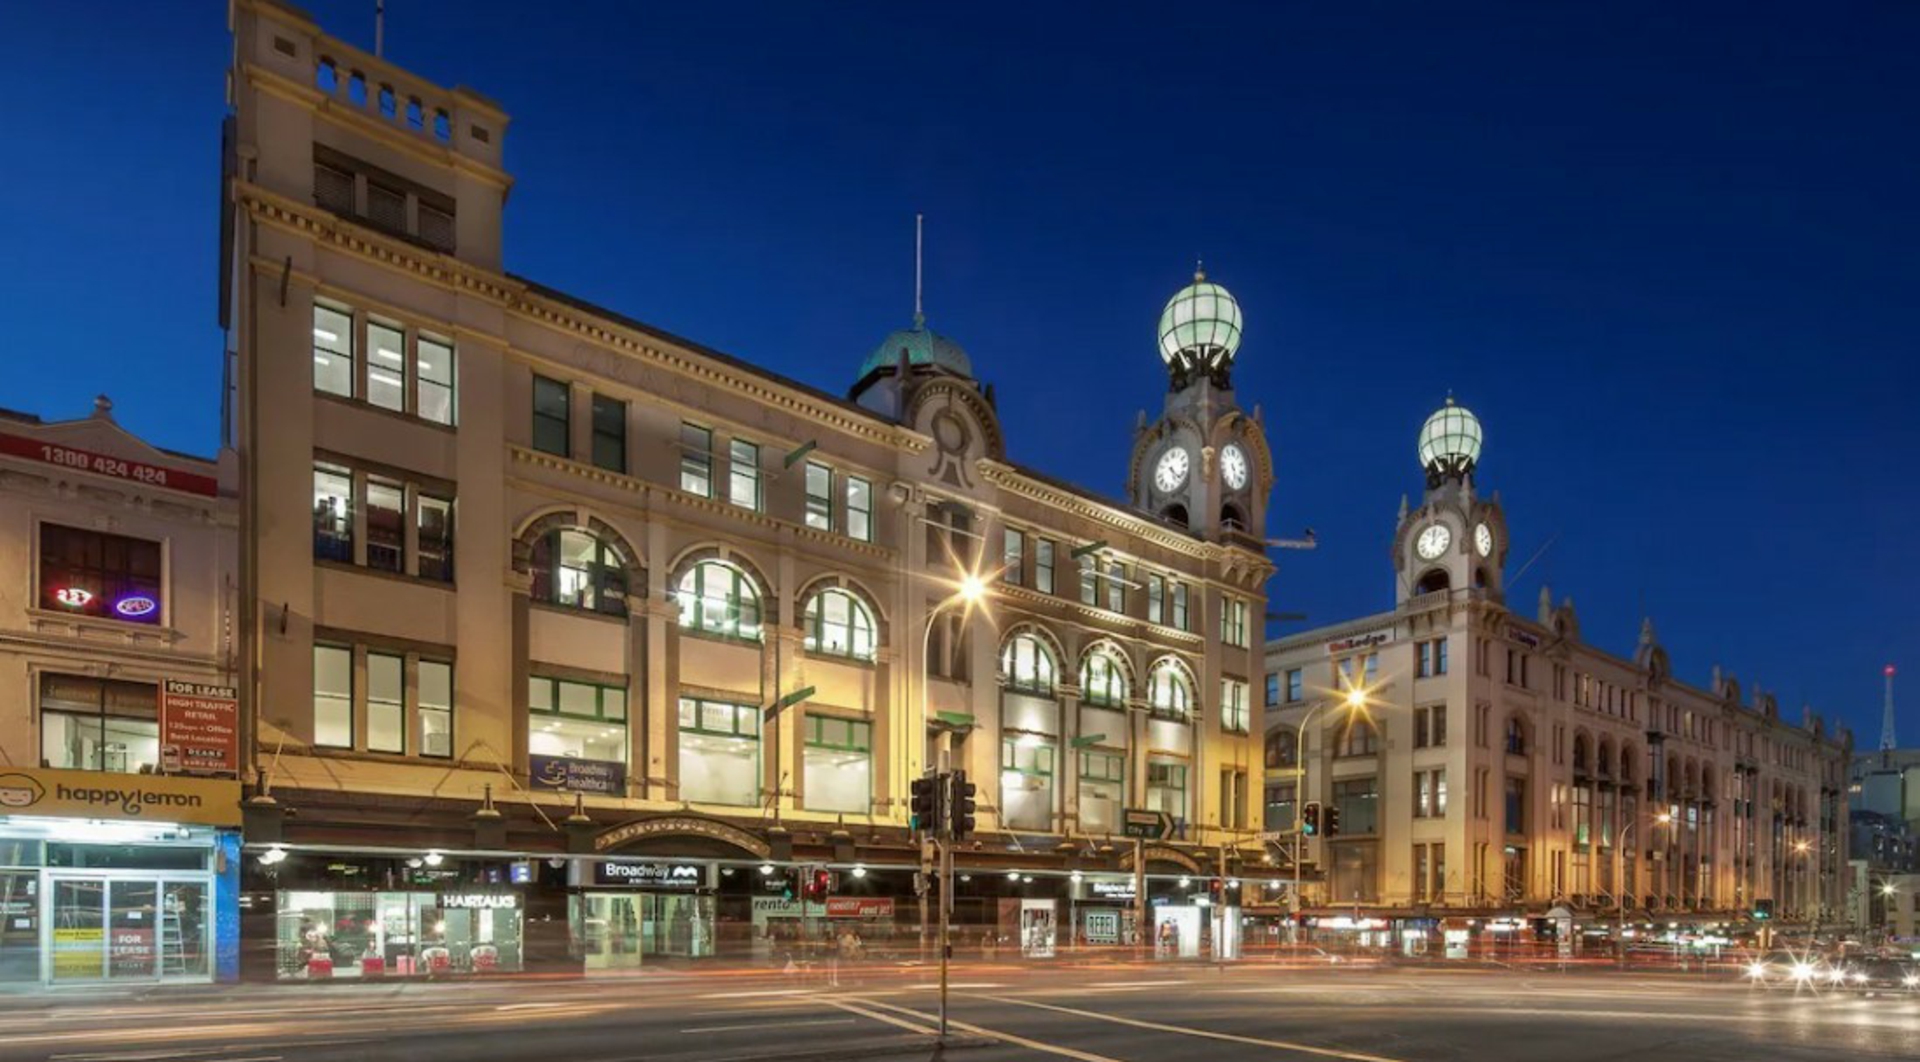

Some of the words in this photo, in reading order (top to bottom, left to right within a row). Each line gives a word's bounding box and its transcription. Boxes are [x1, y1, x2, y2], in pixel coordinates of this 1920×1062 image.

[41, 446, 88, 468] 1300
[94, 458, 128, 477] 424
[133, 467, 167, 485] 424
[169, 682, 193, 694] FOR
[196, 686, 233, 697] LEASE
[167, 698, 193, 708] HIGH
[195, 701, 234, 712] TRAFFIC
[184, 711, 216, 720] RETAIL
[206, 725, 233, 733] Office
[56, 783, 202, 815] happylemon
[605, 863, 670, 880] Broadway
[443, 894, 516, 907] HAIRTALKS
[118, 934, 142, 944] FOR
[114, 946, 150, 956] LEASE
